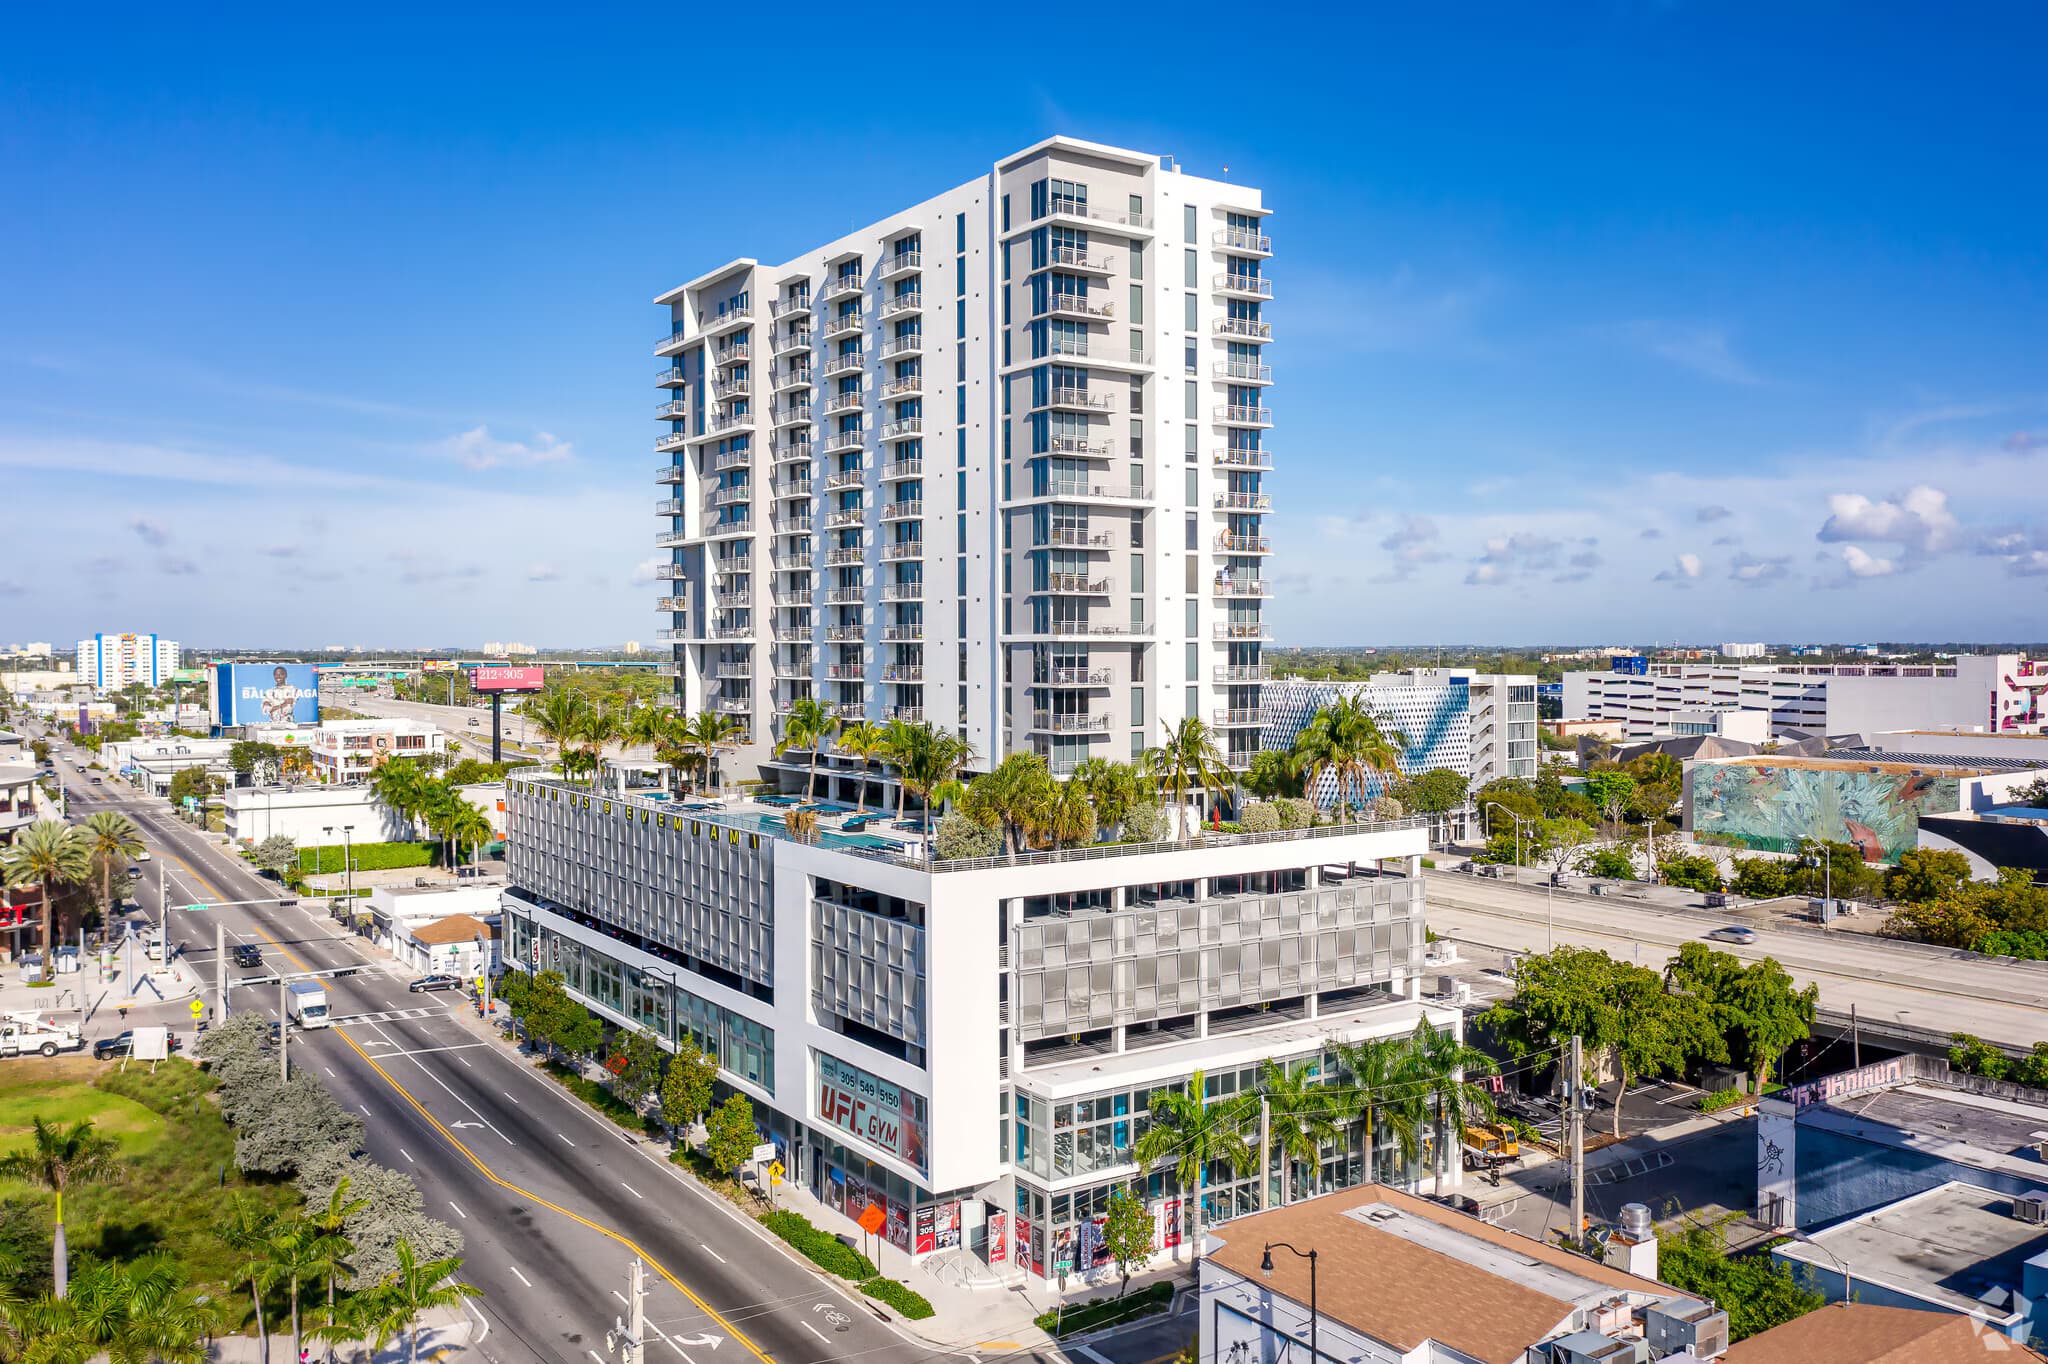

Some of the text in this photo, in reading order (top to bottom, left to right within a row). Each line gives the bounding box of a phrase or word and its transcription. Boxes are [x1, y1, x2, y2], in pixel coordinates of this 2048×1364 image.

[479, 669, 524, 680] 212+305
[242, 688, 318, 699] BALENCIAGA
[507, 779, 558, 801] VISIT
[569, 792, 590, 810] US
[603, 801, 611, 815] @
[841, 1072, 899, 1108] 305 549 5150
[821, 1085, 898, 1147] UFC GYM
[920, 1226, 934, 1235] 305
